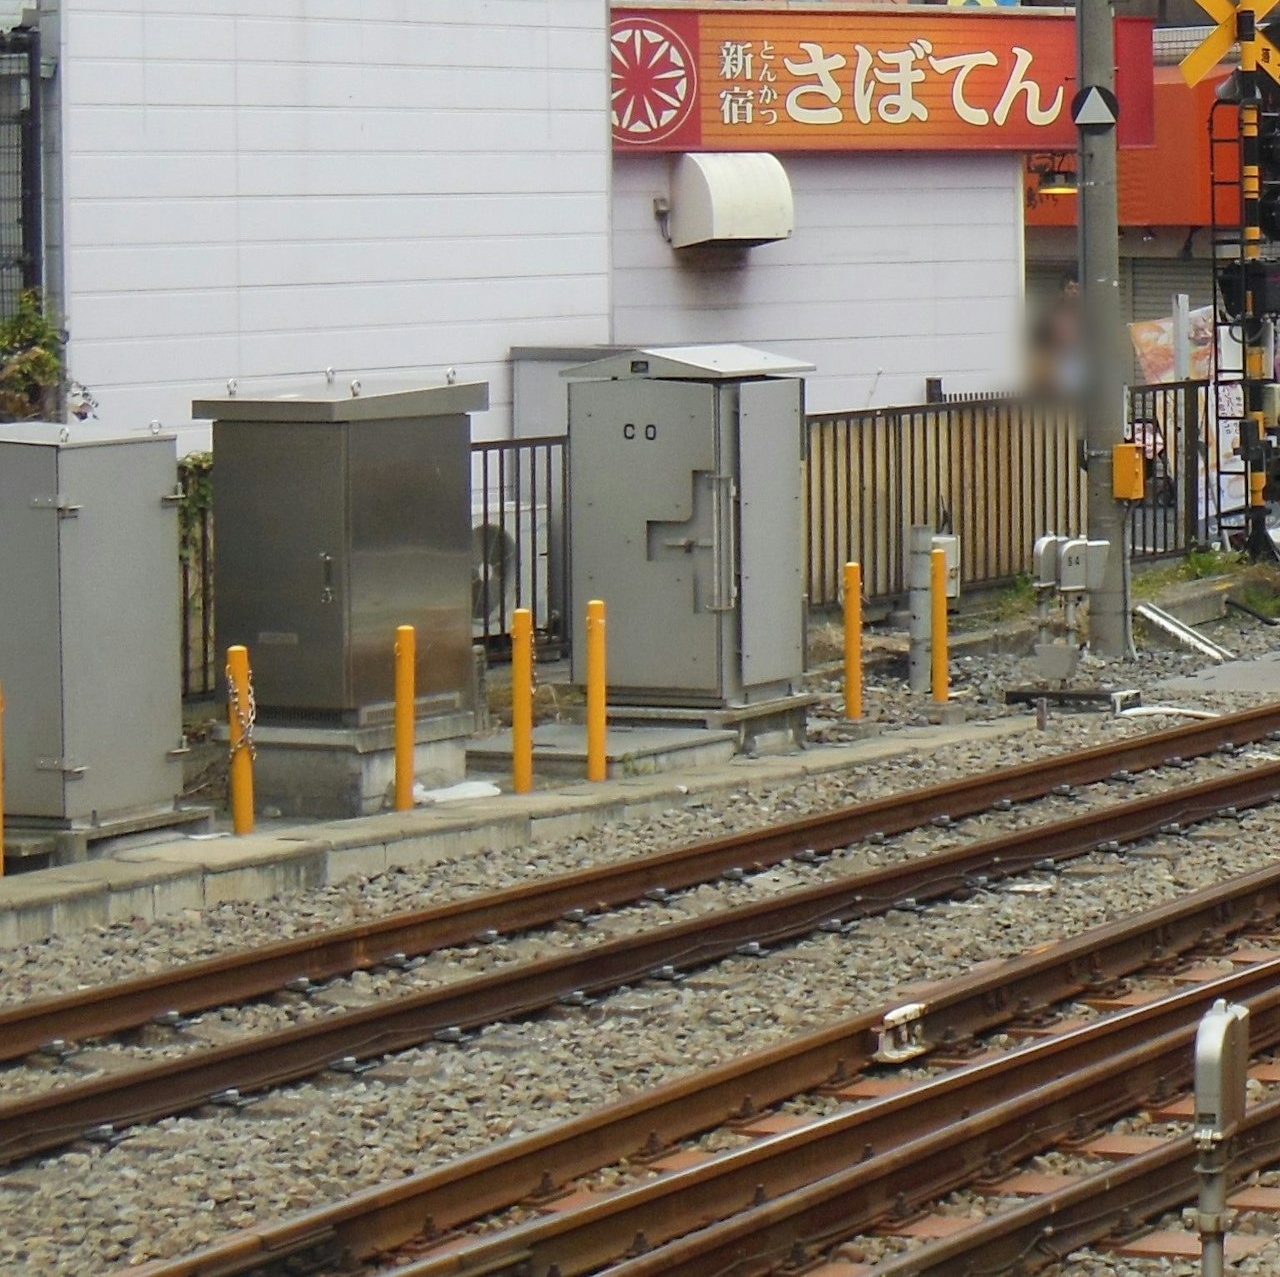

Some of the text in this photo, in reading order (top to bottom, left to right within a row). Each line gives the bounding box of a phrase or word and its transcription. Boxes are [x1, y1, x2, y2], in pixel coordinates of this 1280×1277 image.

[719, 41, 755, 125] 新宿
[759, 40, 778, 126] とんかつ
[783, 38, 1065, 127] さぼてん
